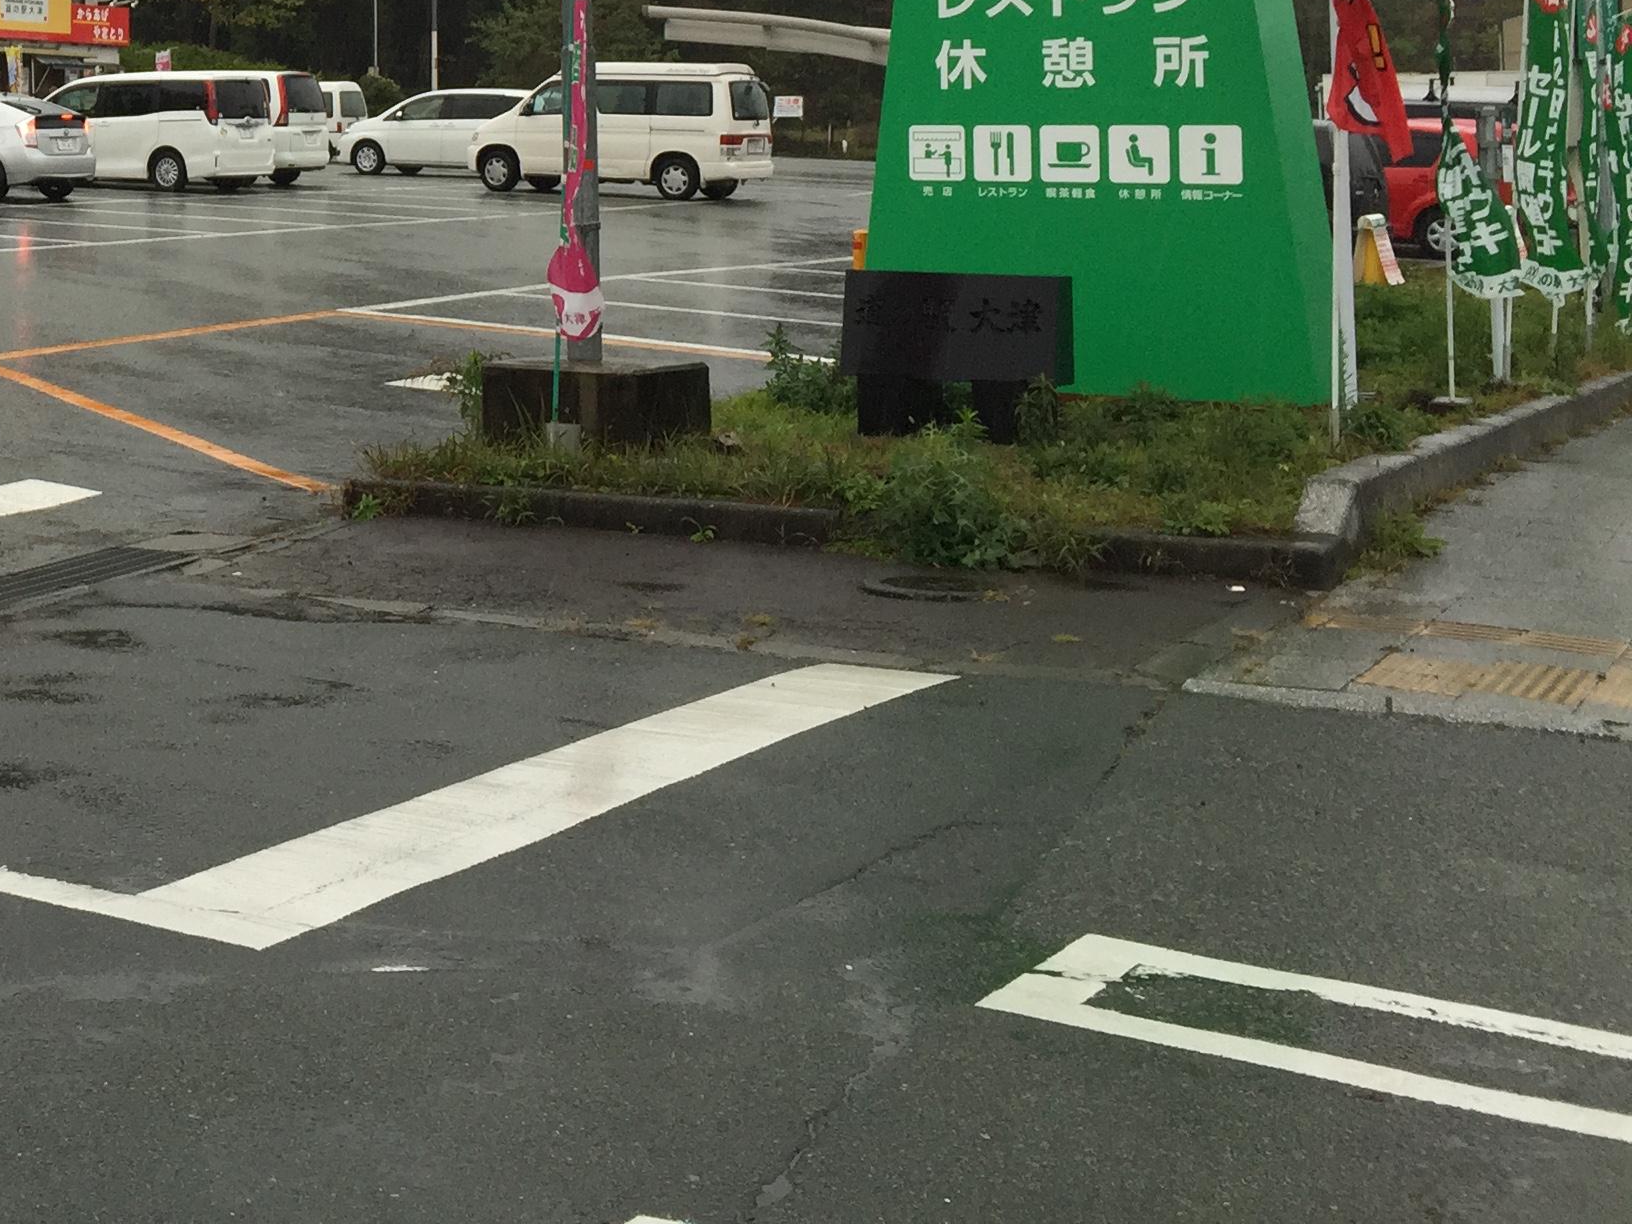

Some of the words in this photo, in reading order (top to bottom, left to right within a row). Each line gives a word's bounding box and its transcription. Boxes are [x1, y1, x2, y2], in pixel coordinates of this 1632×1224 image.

[76, 7, 109, 22] からあげ
[935, 35, 1210, 91] 休憩所
[978, 186, 1028, 198] レストラン
[1119, 188, 1162, 200] 休憩所
